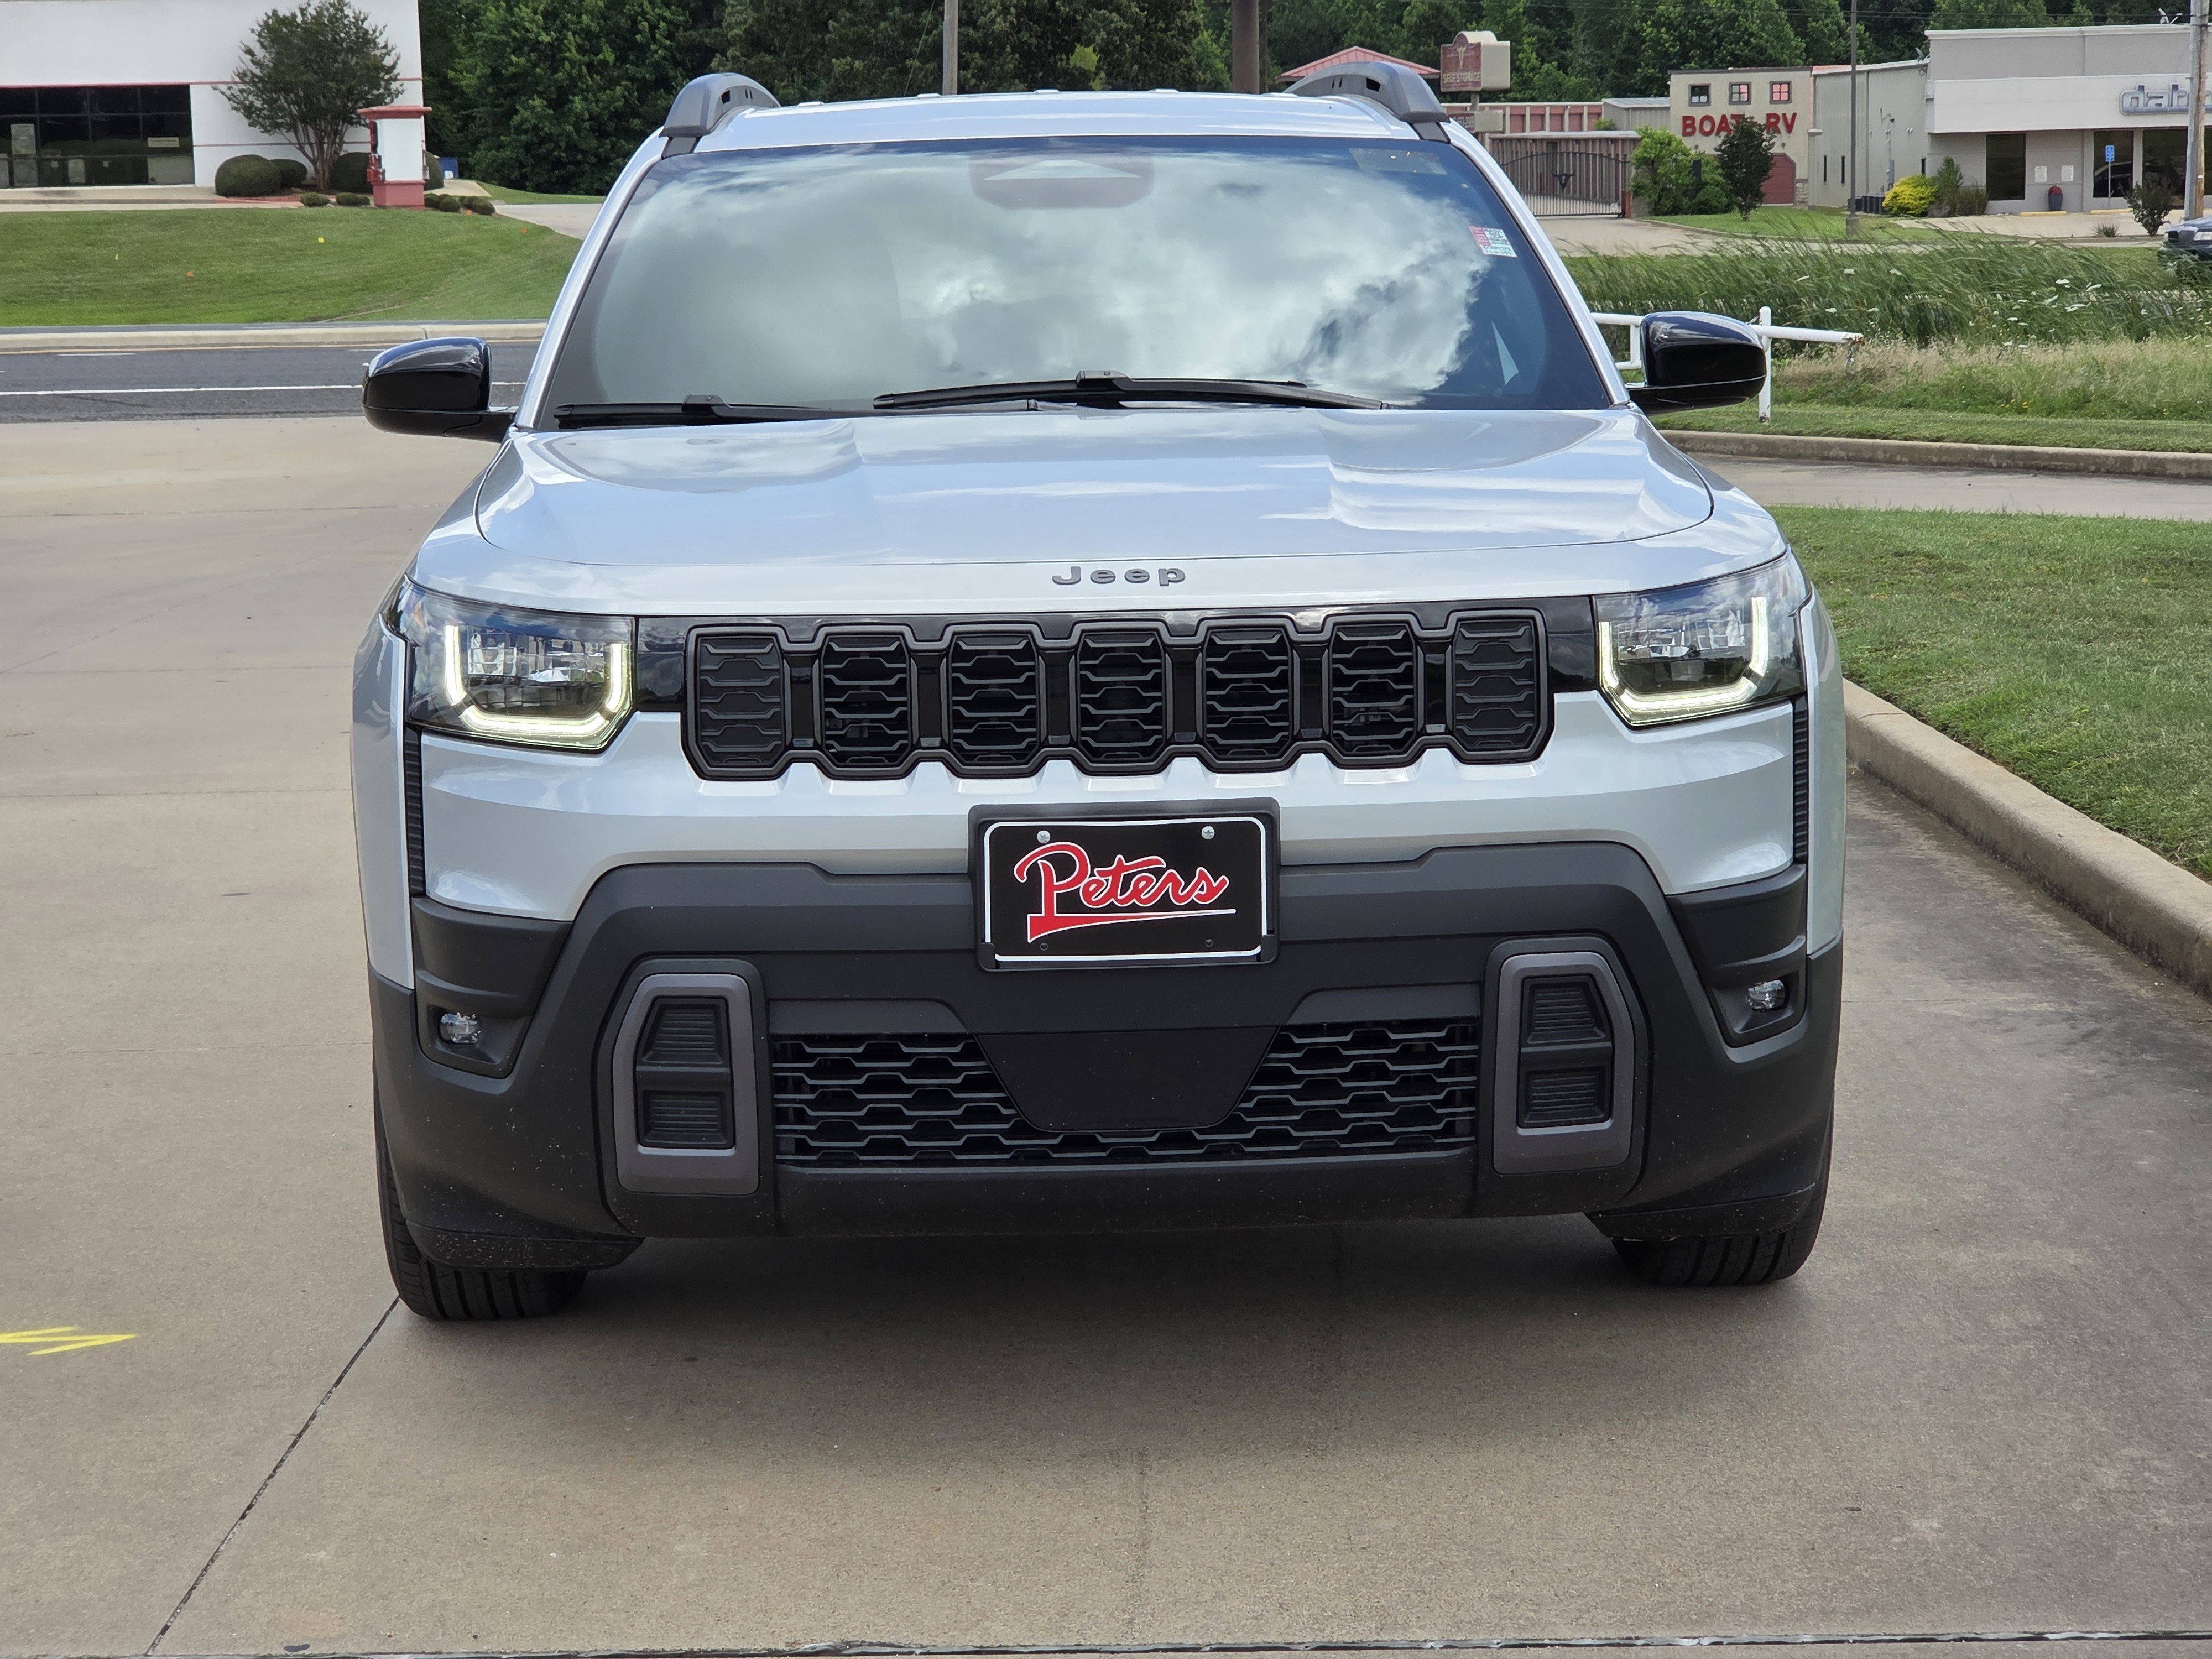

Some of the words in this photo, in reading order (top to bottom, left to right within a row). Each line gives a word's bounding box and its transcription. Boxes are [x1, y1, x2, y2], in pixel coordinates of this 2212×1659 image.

[1682, 113, 1745, 137] BOAT
[1766, 112, 1797, 134] RV
[1052, 566, 1186, 587] Jeep
[1014, 842, 1236, 942] Peters
